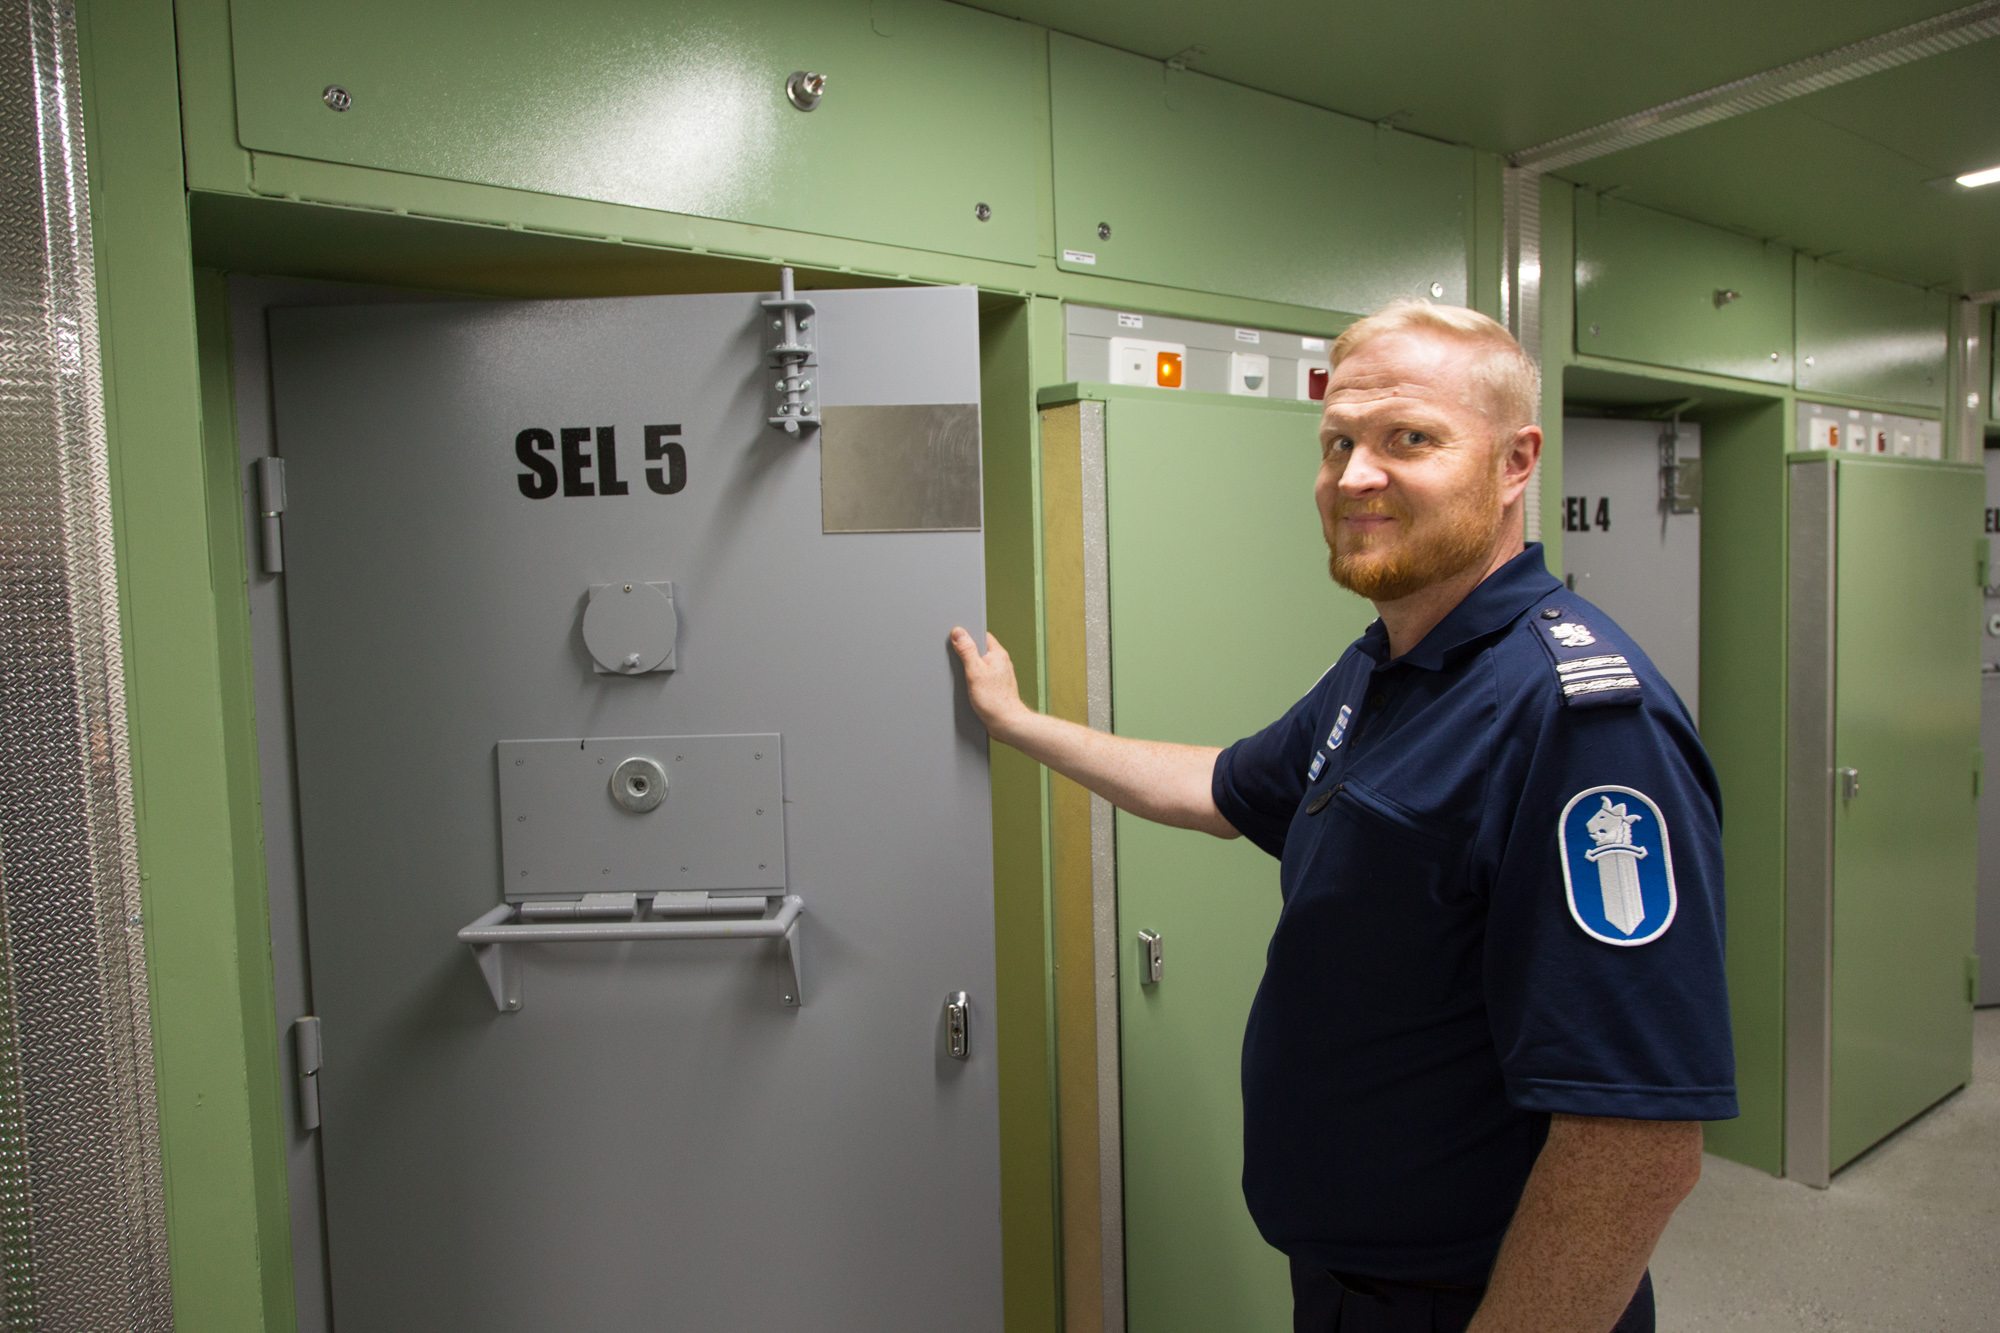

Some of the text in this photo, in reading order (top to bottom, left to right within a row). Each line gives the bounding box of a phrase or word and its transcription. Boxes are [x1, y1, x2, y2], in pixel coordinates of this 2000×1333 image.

[515, 424, 687, 499] SEL 5
[1562, 496, 1611, 532] EL 4
